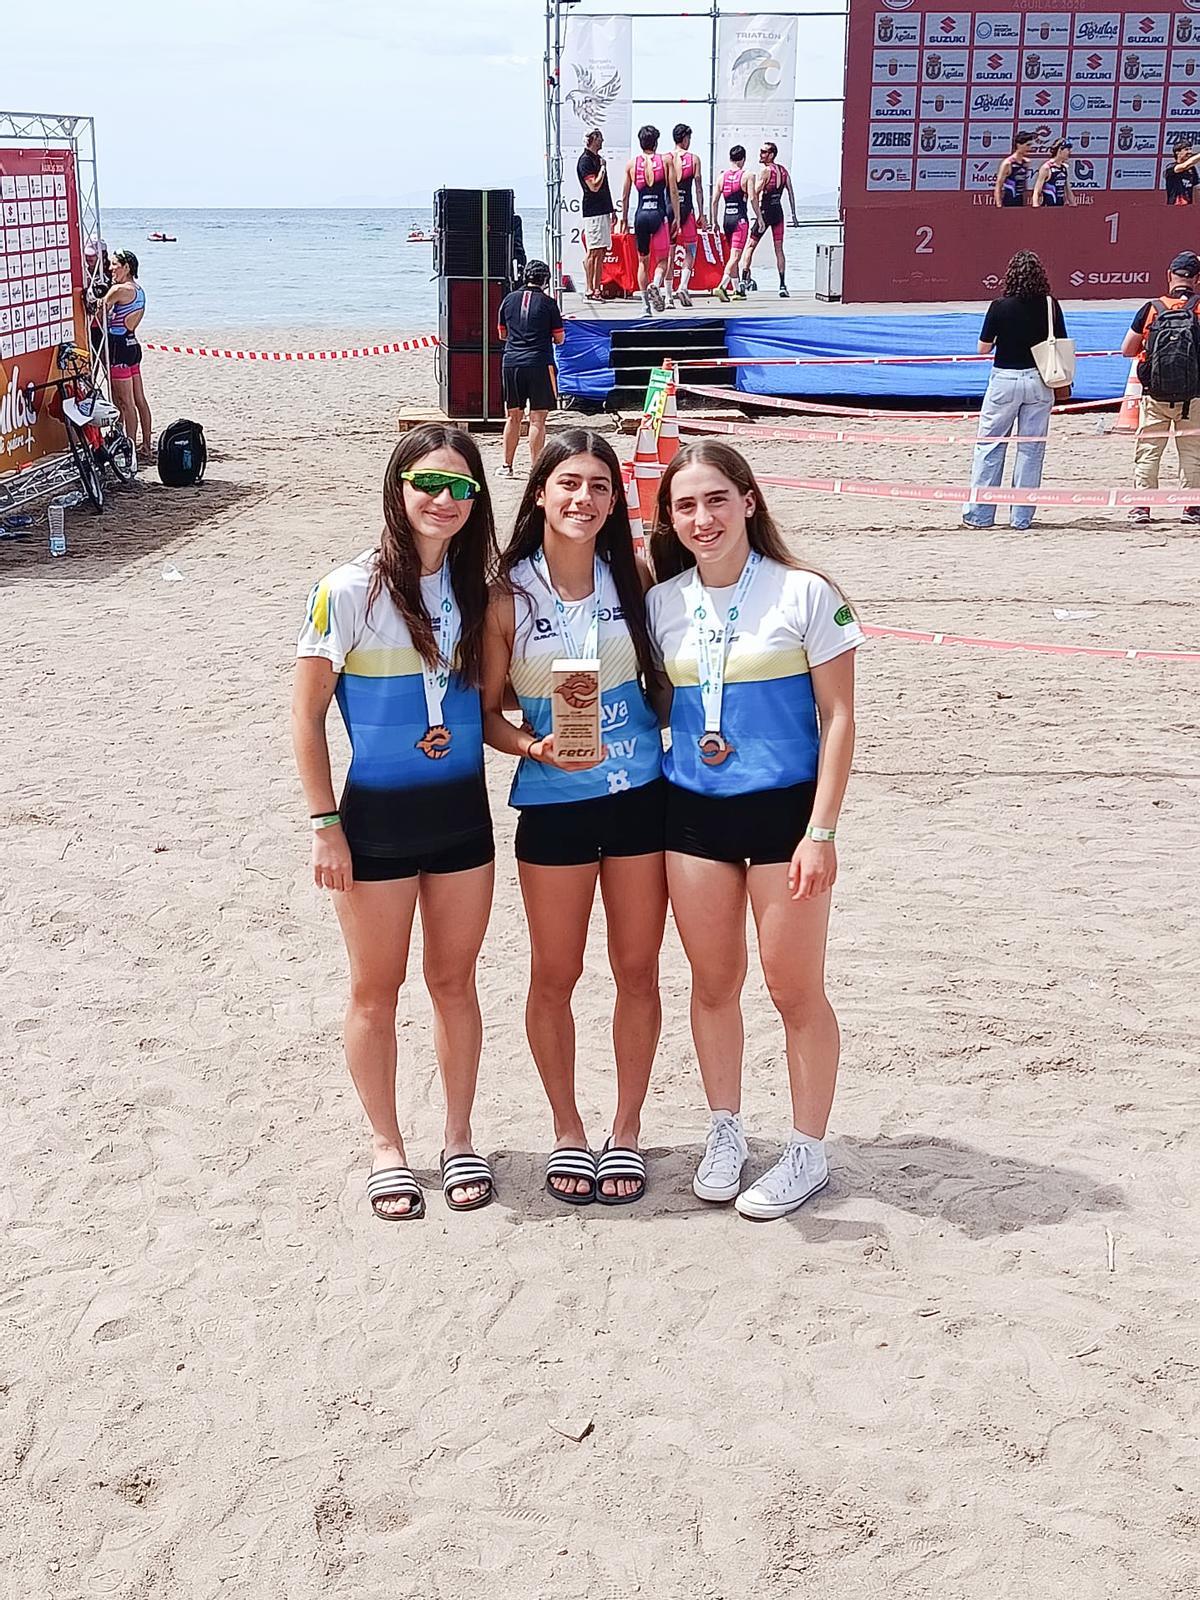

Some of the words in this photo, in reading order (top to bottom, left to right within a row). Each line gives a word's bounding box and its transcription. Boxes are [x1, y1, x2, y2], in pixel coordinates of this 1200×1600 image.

[872, 132, 912, 147] 226ERS
[1166, 131, 1200, 146] 226ER
[972, 173, 997, 182] Halcó
[1105, 212, 1119, 244] 1
[915, 226, 934, 254] 2
[1088, 272, 1150, 284] SUZUKI
